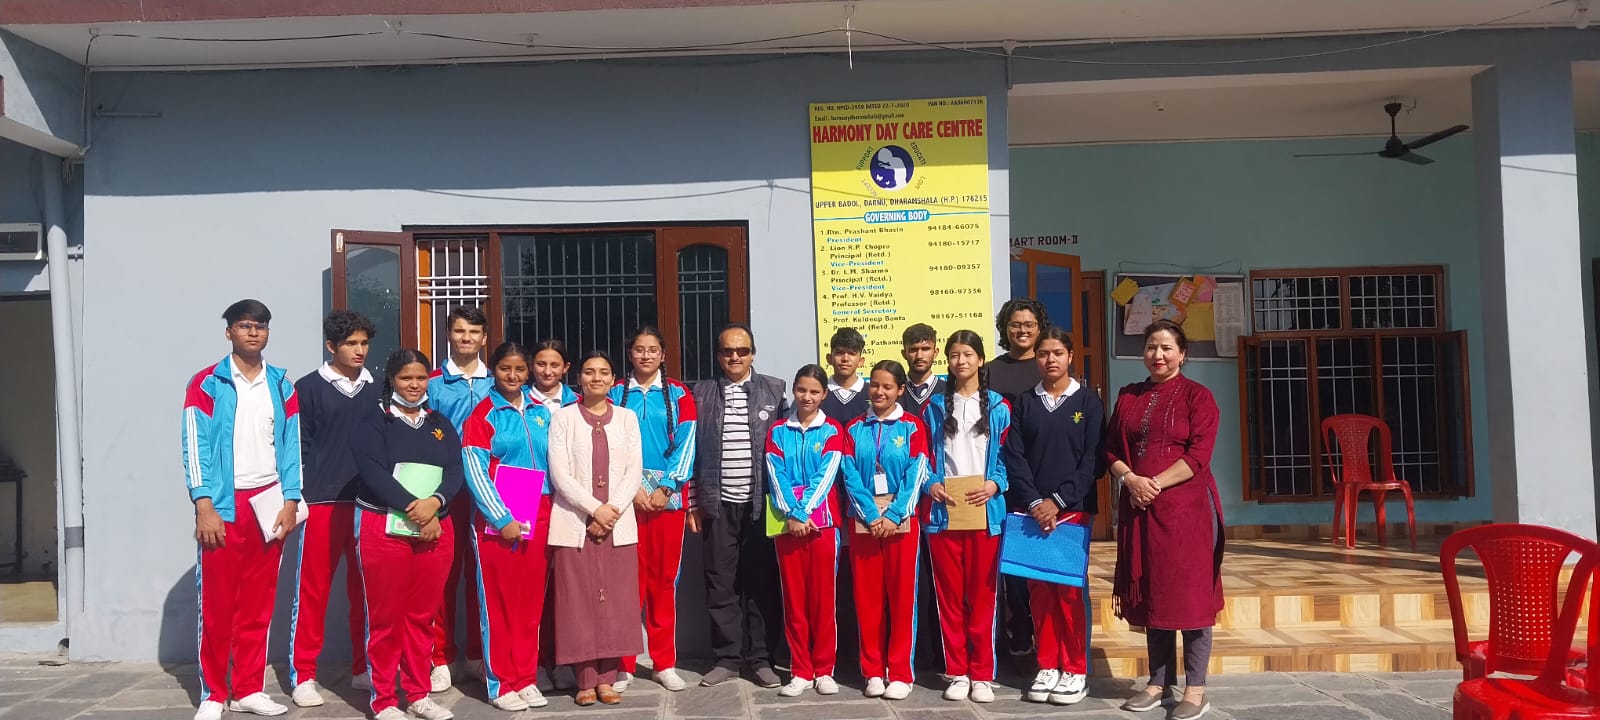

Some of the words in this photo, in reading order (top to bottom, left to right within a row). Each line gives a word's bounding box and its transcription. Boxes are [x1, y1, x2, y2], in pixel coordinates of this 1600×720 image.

[813, 124, 872, 143] HARMONY
[875, 123, 900, 140] DAY
[903, 121, 933, 139] CARE
[936, 118, 983, 138] CENTRE
[856, 145, 874, 170] SUPPORT
[910, 141, 927, 165] EDUCATE
[889, 196, 938, 206] DHARAMSHALA
[962, 194, 988, 202] 176215
[865, 211, 906, 222] GOVERNING
[908, 210, 928, 220] BODY
